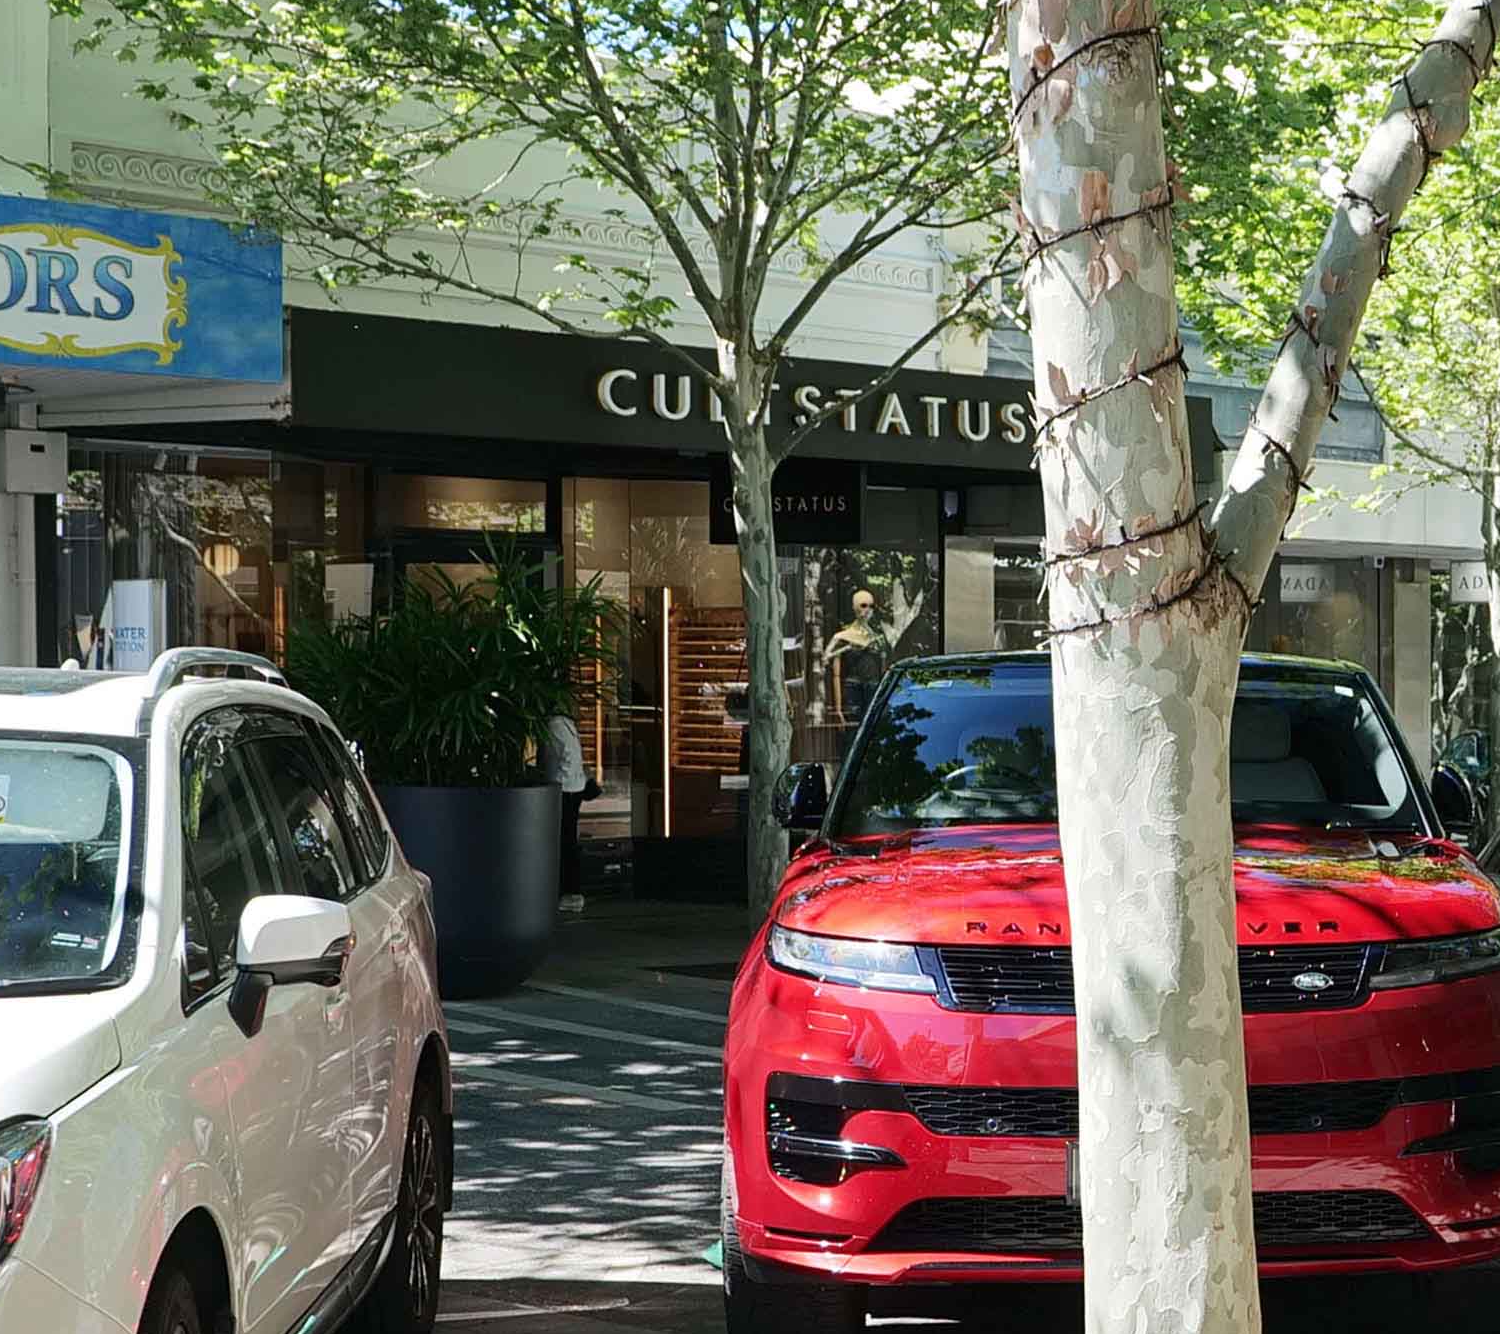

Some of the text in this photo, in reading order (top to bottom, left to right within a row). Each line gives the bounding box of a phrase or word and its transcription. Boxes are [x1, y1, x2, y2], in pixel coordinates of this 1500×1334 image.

[1458, 575, 1484, 590] AD
[964, 920, 1340, 937] RAN VER
